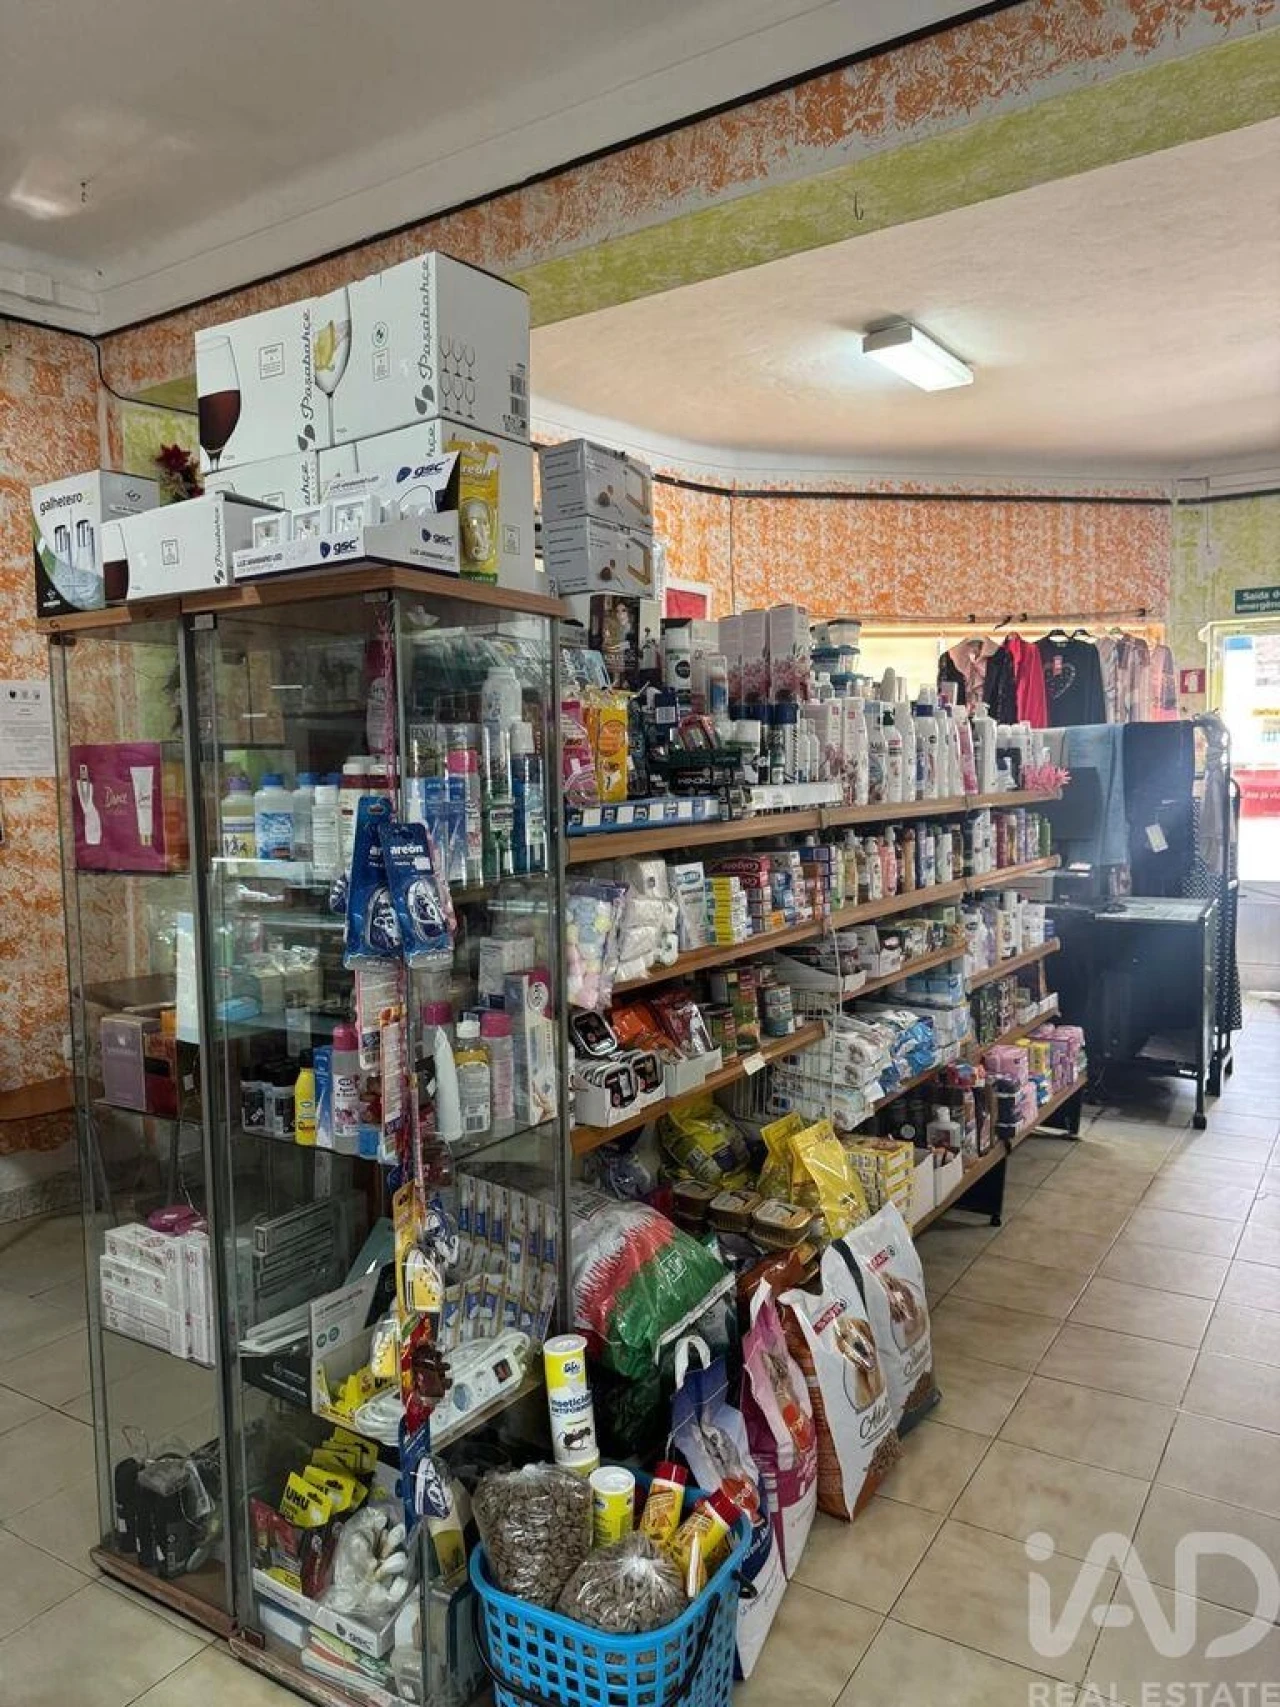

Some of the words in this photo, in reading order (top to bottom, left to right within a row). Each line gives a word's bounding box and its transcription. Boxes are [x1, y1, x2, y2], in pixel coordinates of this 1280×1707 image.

[39, 492, 83, 515] galheteiro
[332, 539, 357, 555] gsc
[286, 1484, 309, 1510] UHU
